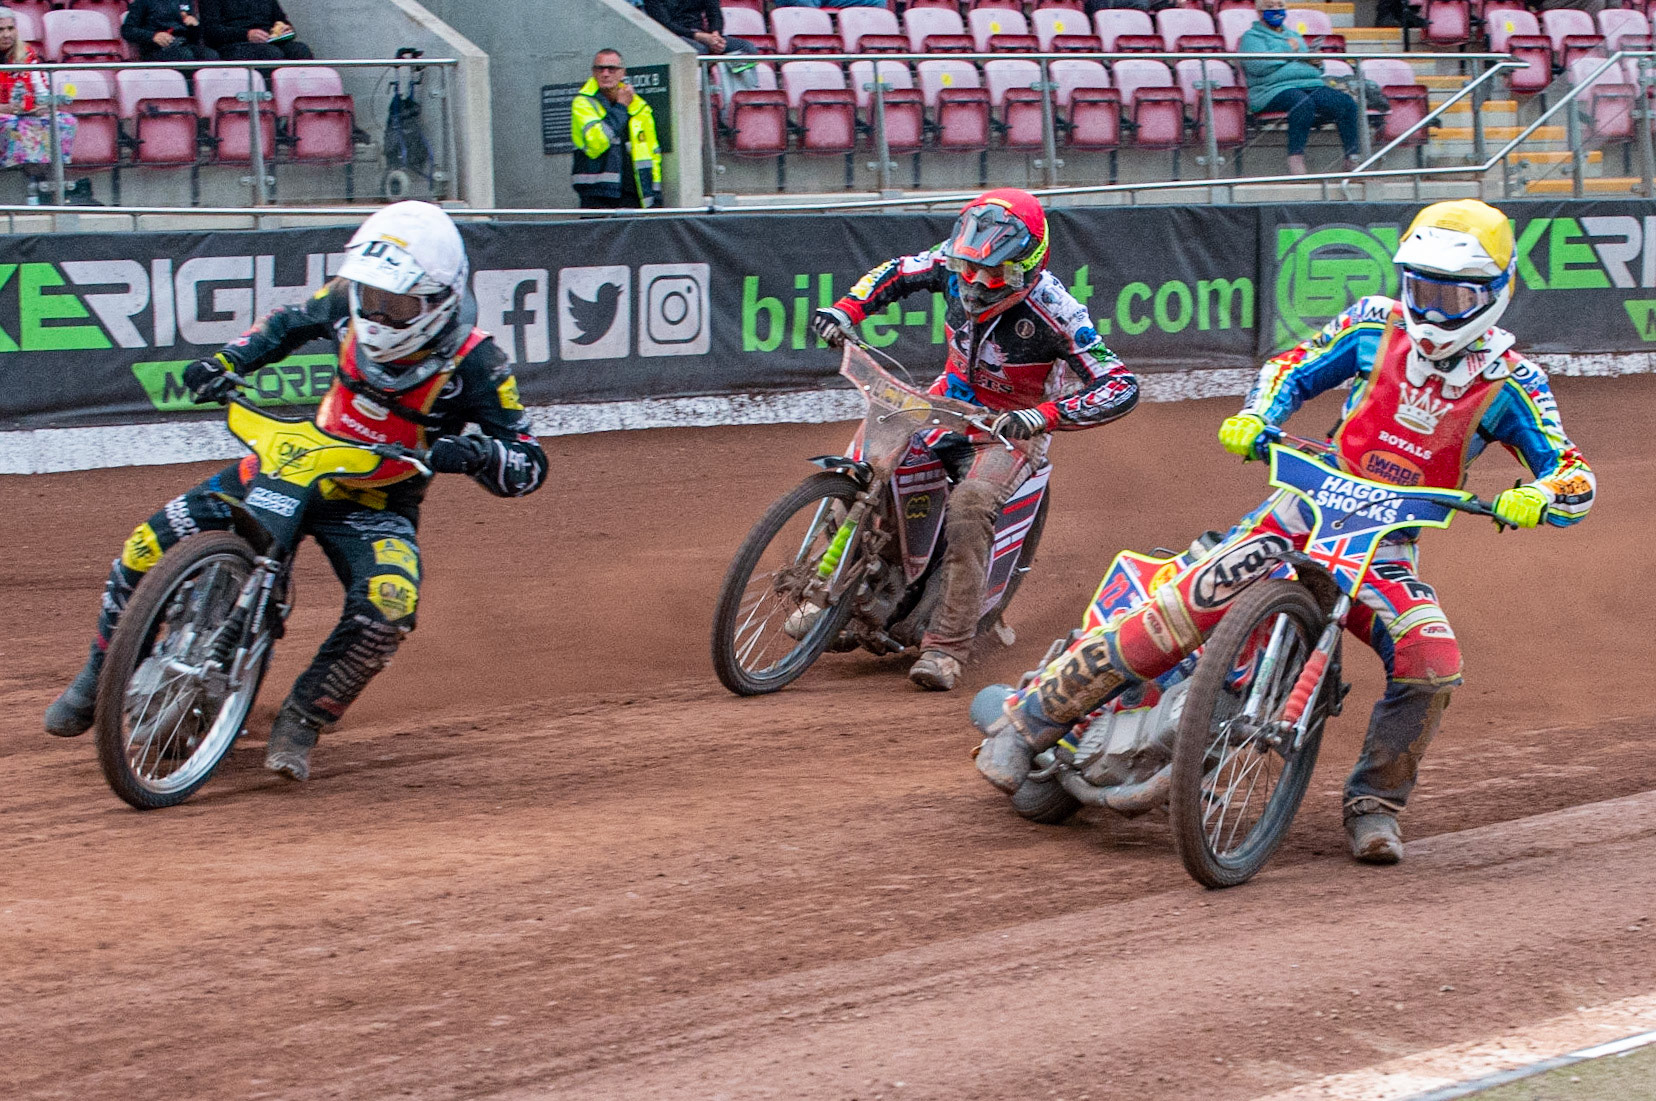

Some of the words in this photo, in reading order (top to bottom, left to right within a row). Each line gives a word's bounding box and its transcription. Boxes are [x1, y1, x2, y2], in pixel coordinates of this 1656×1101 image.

[340, 413, 388, 442] ROYALS
[1378, 430, 1433, 460] ROYALS
[1369, 454, 1421, 482] IWADE
[1316, 491, 1398, 524] SHOCKS
[1321, 476, 1405, 510] HAGON
[1207, 539, 1272, 602] Arai
